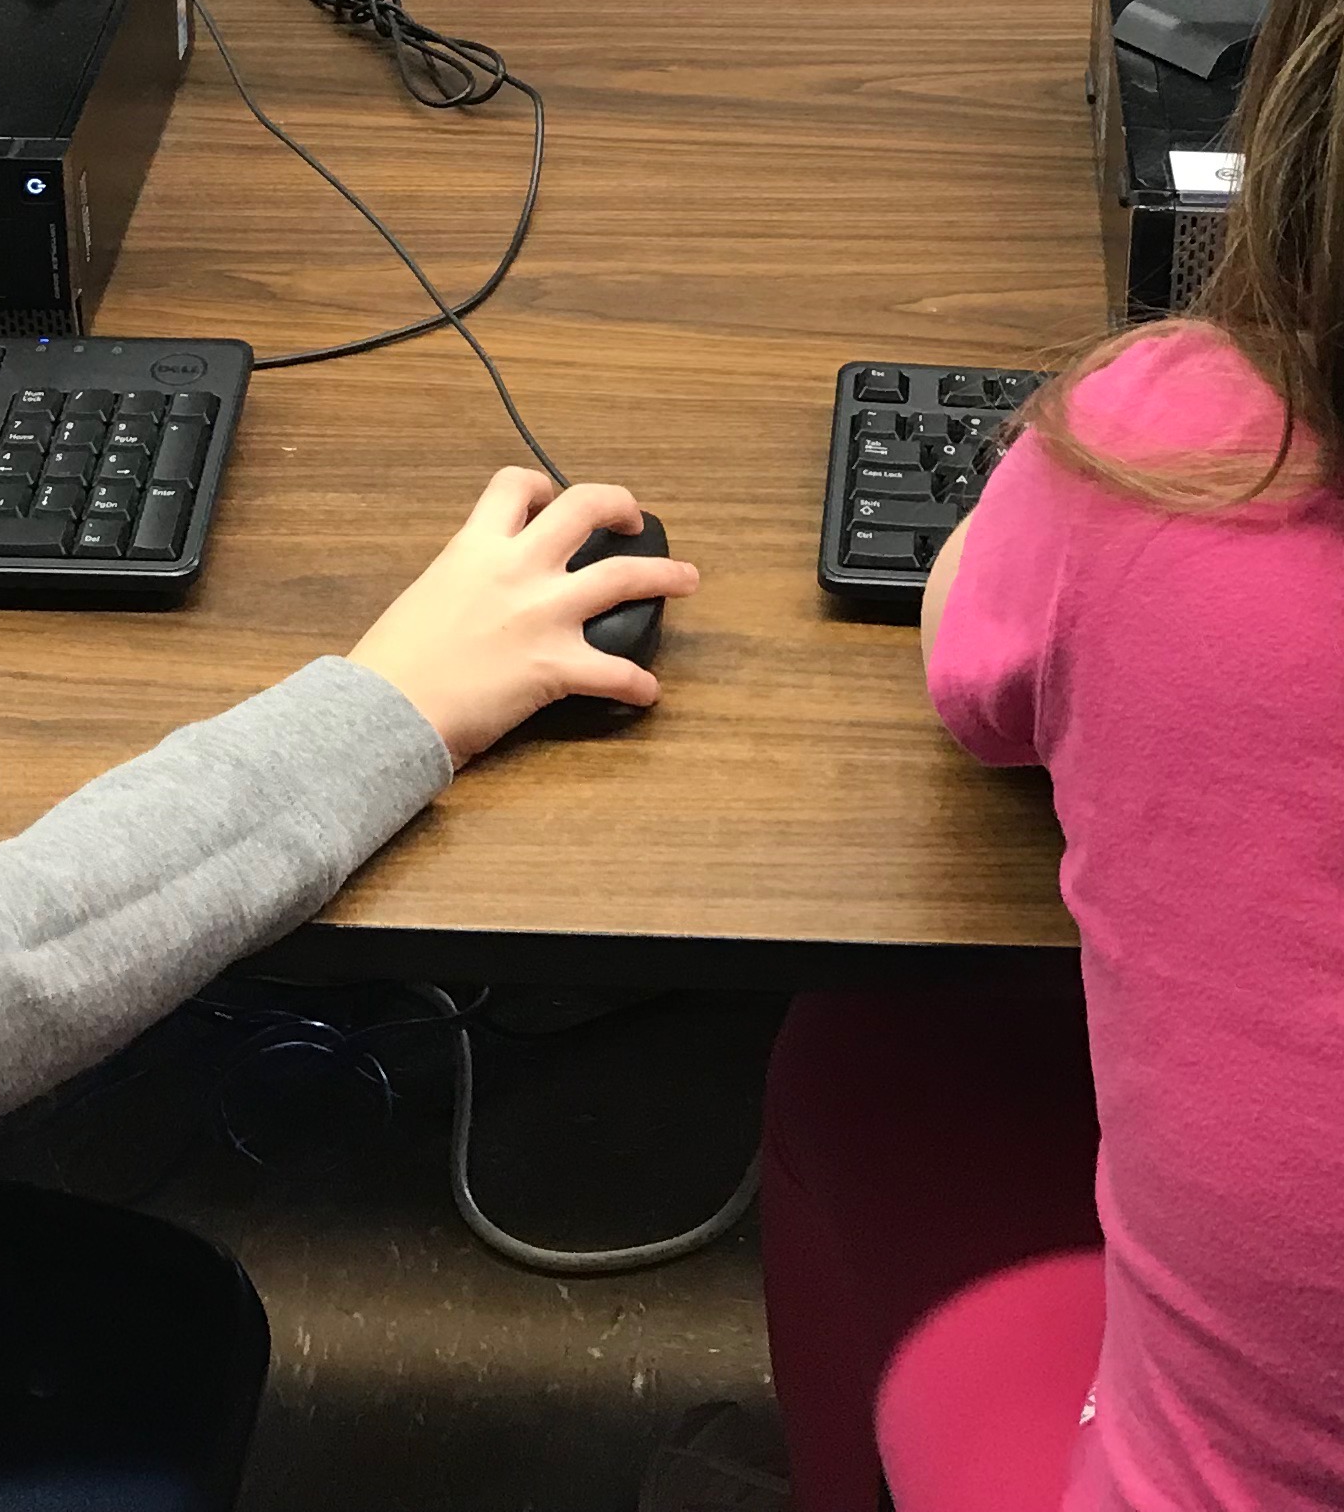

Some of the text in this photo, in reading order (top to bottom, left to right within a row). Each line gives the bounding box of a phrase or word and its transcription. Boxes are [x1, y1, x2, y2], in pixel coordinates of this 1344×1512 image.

[1006, 378, 1017, 386] F2
[66, 422, 74, 430] 8
[119, 423, 126, 431] 9
[944, 445, 955, 455] Q
[56, 453, 63, 461] 5
[109, 455, 117, 463] 6
[863, 469, 882, 478] Caps
[956, 475, 968, 484] A
[44, 486, 53, 494] 2
[99, 488, 106, 496] 3
[860, 499, 880, 507] Shift
[857, 531, 872, 539] Ctrl
